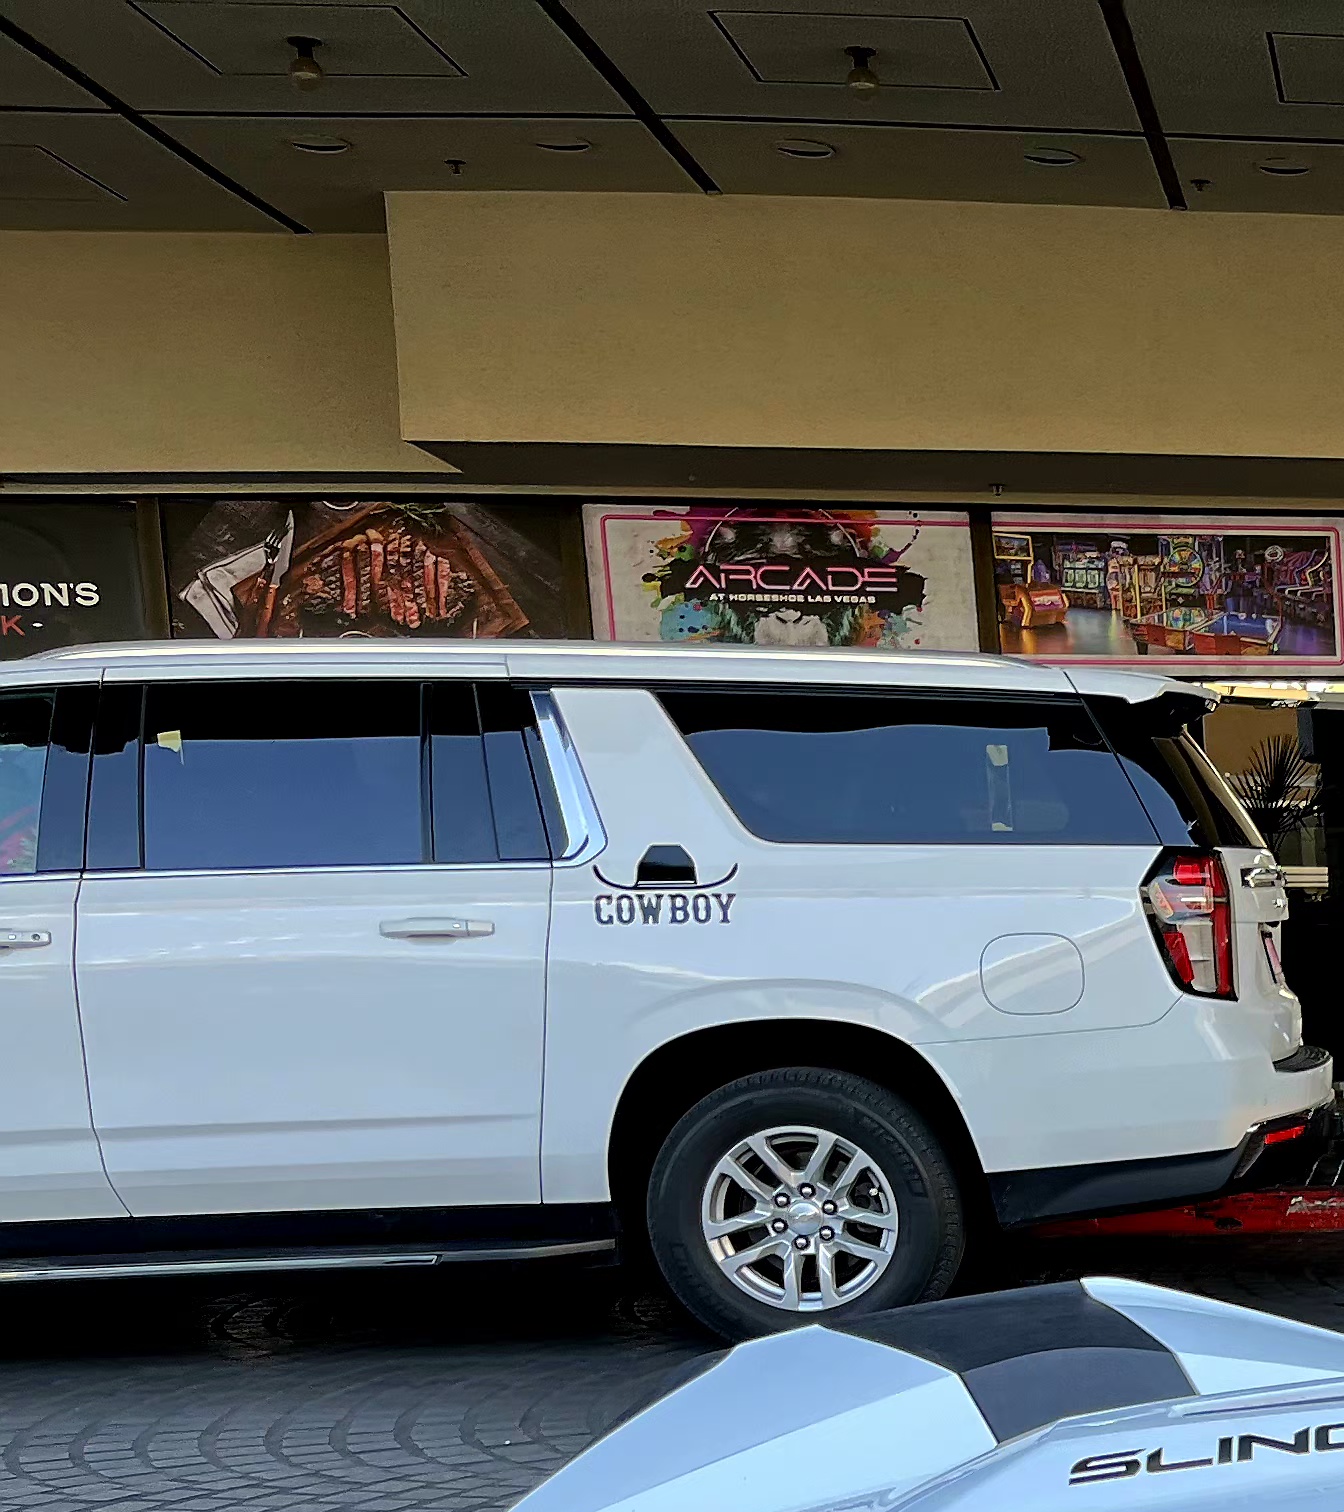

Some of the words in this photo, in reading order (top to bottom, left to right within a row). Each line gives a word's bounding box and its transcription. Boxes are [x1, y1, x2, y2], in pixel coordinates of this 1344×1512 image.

[685, 564, 898, 591] ARCADE
[709, 593, 725, 601] AT
[729, 593, 804, 603] HORSESHOE
[807, 593, 831, 603] LAS
[834, 594, 876, 604] VEGAS
[594, 893, 736, 926] COWBOY
